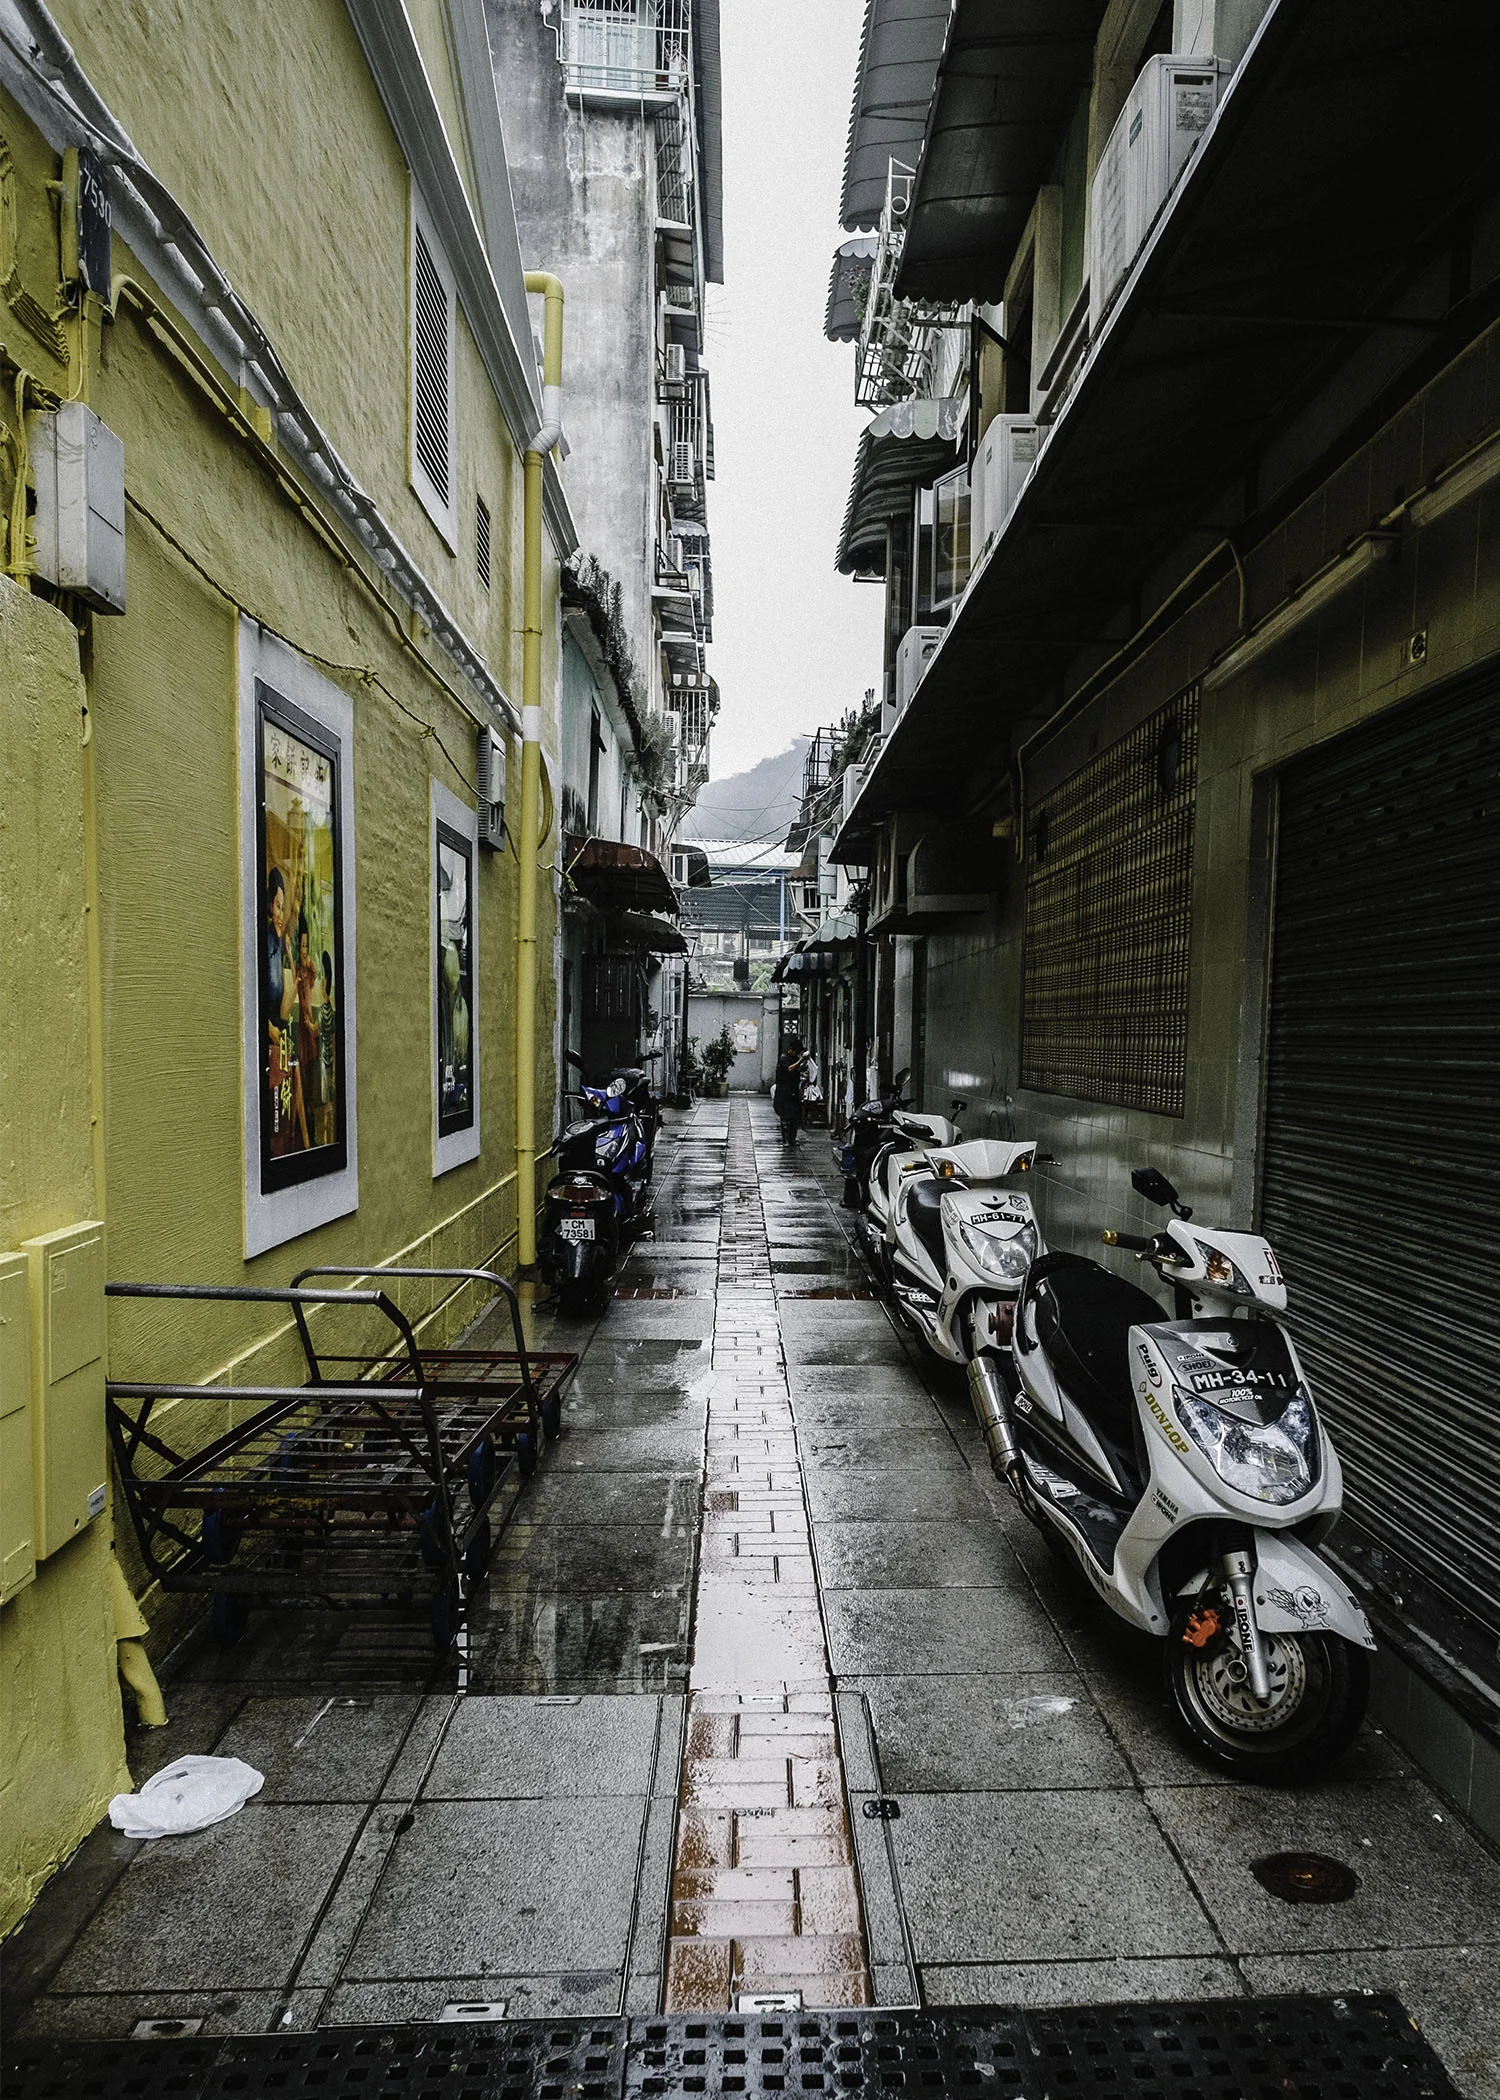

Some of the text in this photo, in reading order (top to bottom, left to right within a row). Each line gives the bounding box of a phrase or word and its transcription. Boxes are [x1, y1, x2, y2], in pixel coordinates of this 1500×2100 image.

[571, 1220, 585, 1229] CM
[972, 1212, 1023, 1224] MH-61-77
[564, 1229, 594, 1239] 73581
[1138, 1343, 1159, 1379] Puig
[1181, 1360, 1212, 1372] SHOEI
[1193, 1369, 1286, 1390] MH-34-11
[1231, 1387, 1254, 1397] 100%
[1143, 1392, 1190, 1454] DUNLOP
[1157, 1487, 1179, 1515] YAMAHA
[1237, 1608, 1253, 1652] IPONE
